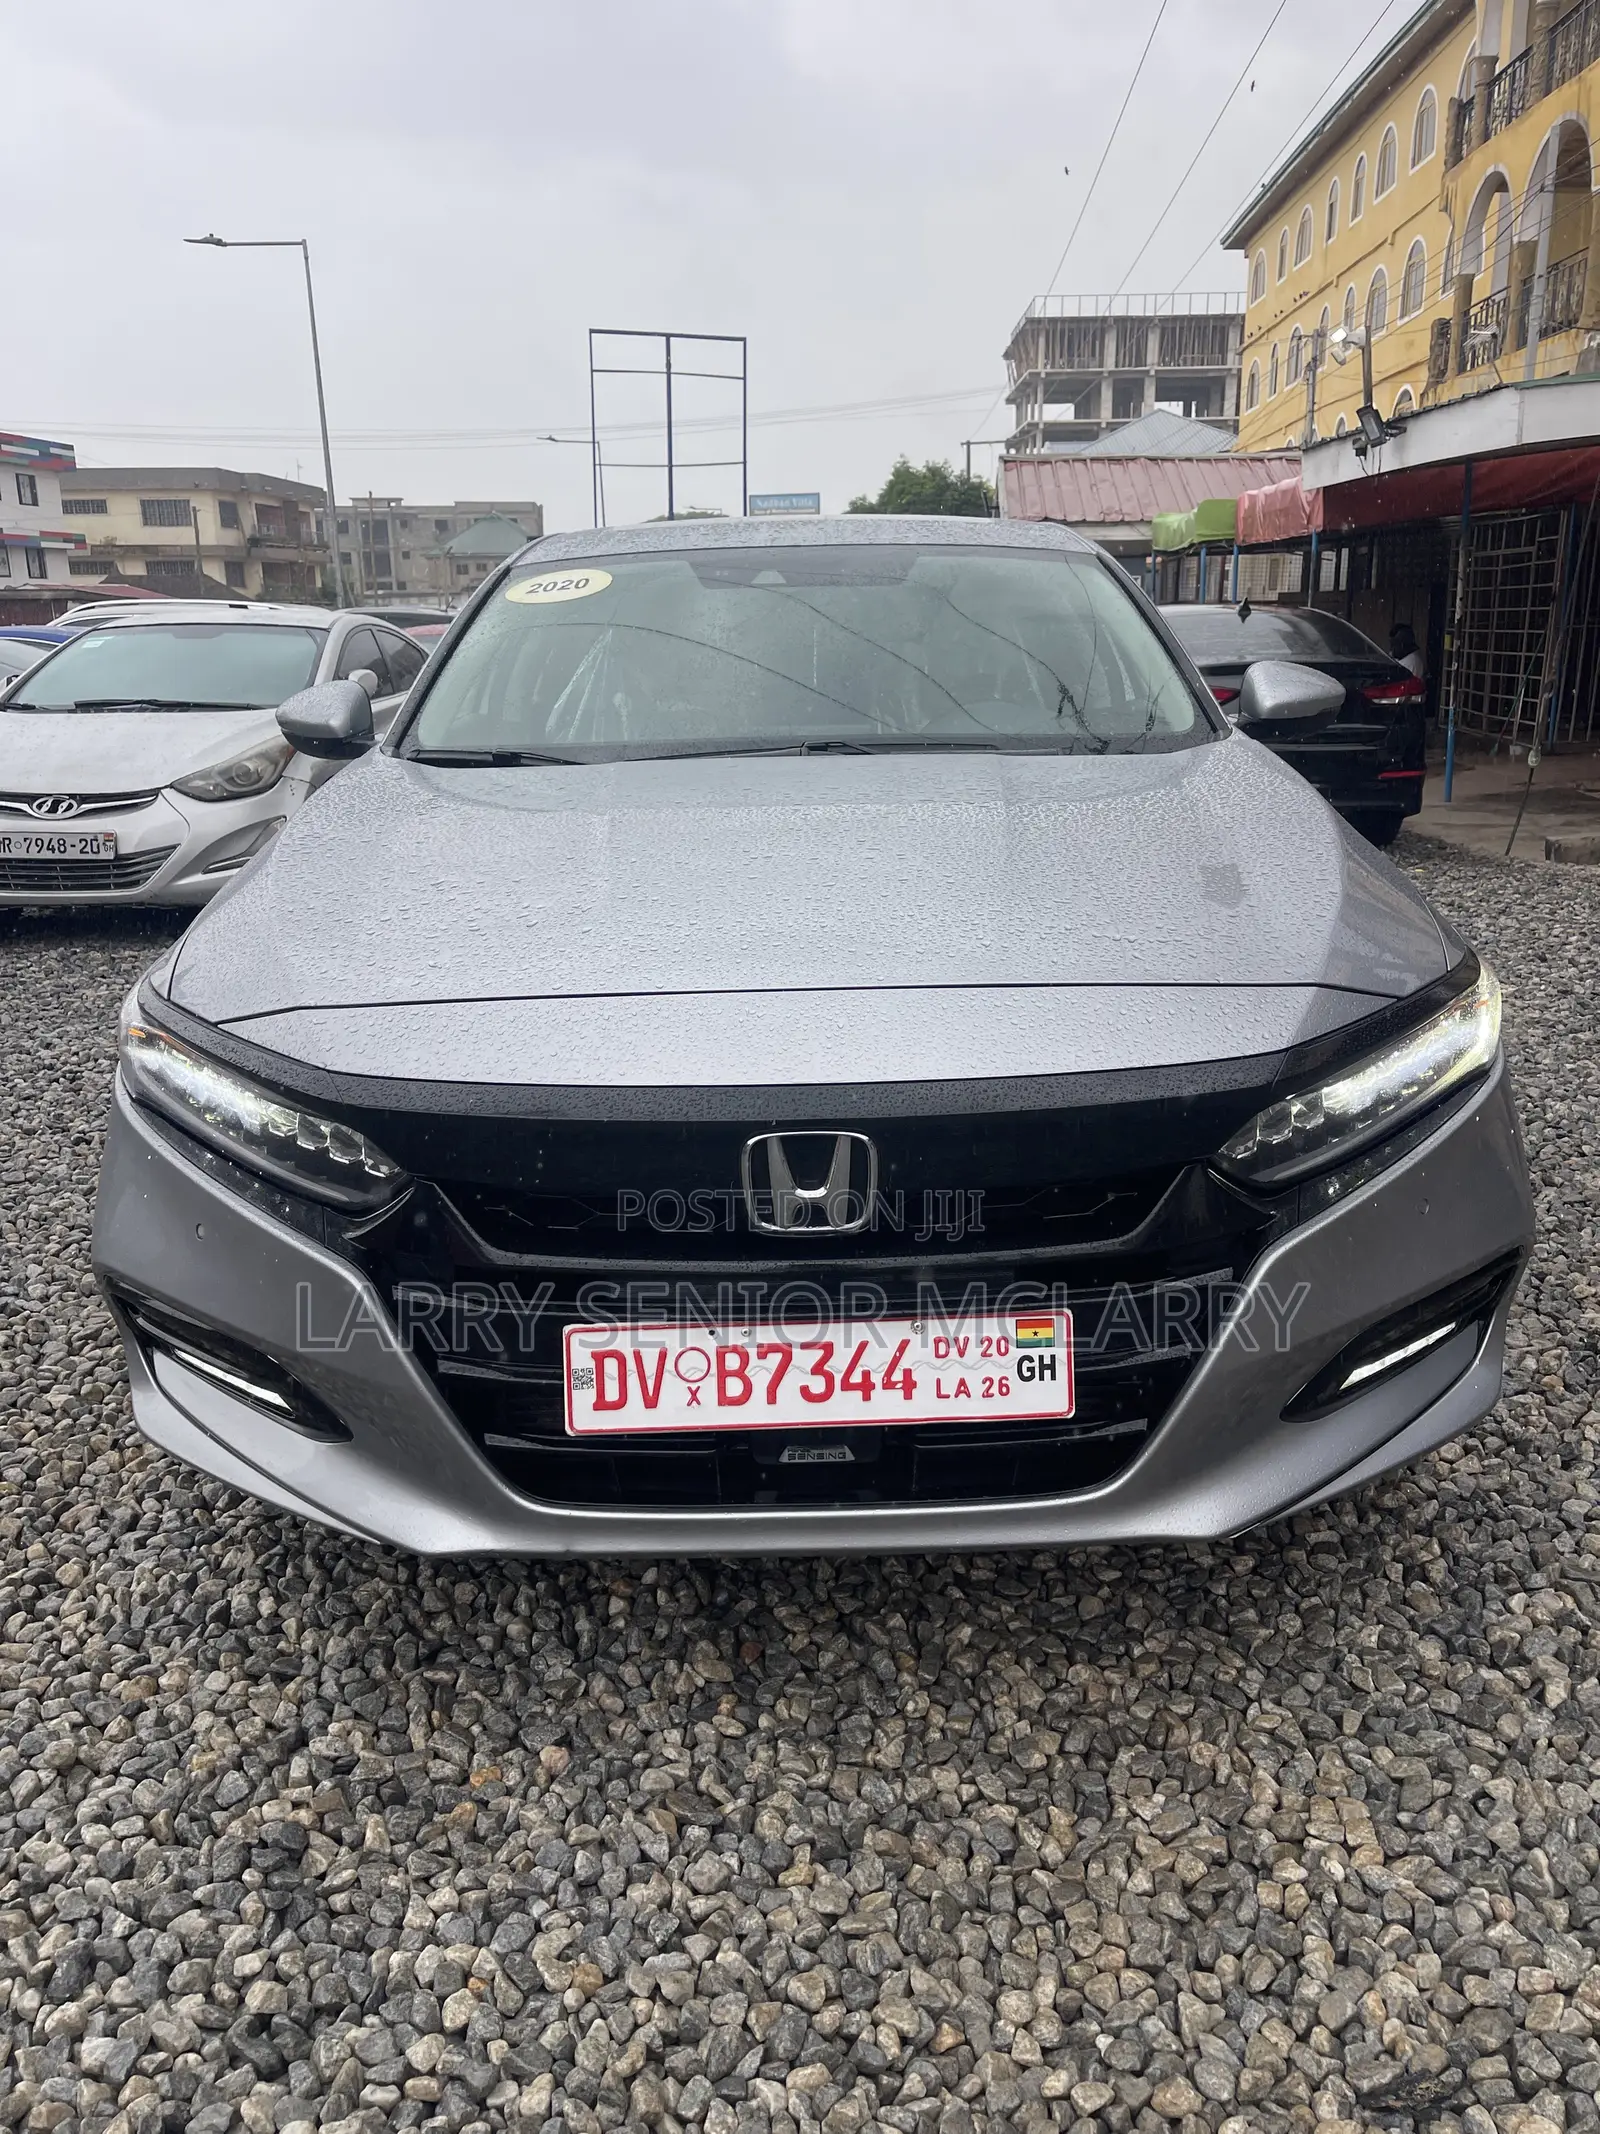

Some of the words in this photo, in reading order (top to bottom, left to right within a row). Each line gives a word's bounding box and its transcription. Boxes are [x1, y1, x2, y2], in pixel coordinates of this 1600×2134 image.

[525, 578, 590, 595] 2020
[23, 836, 101, 855] 7948-20
[103, 844, 114, 853] GH
[933, 1335, 970, 1359] DV
[980, 1335, 1010, 1358] 20
[591, 1347, 667, 1411] DV
[716, 1338, 918, 1407] B7344
[1016, 1354, 1057, 1382] GH
[936, 1377, 971, 1399] LA
[981, 1375, 1011, 1398] 26
[787, 1451, 847, 1461] SENSING
